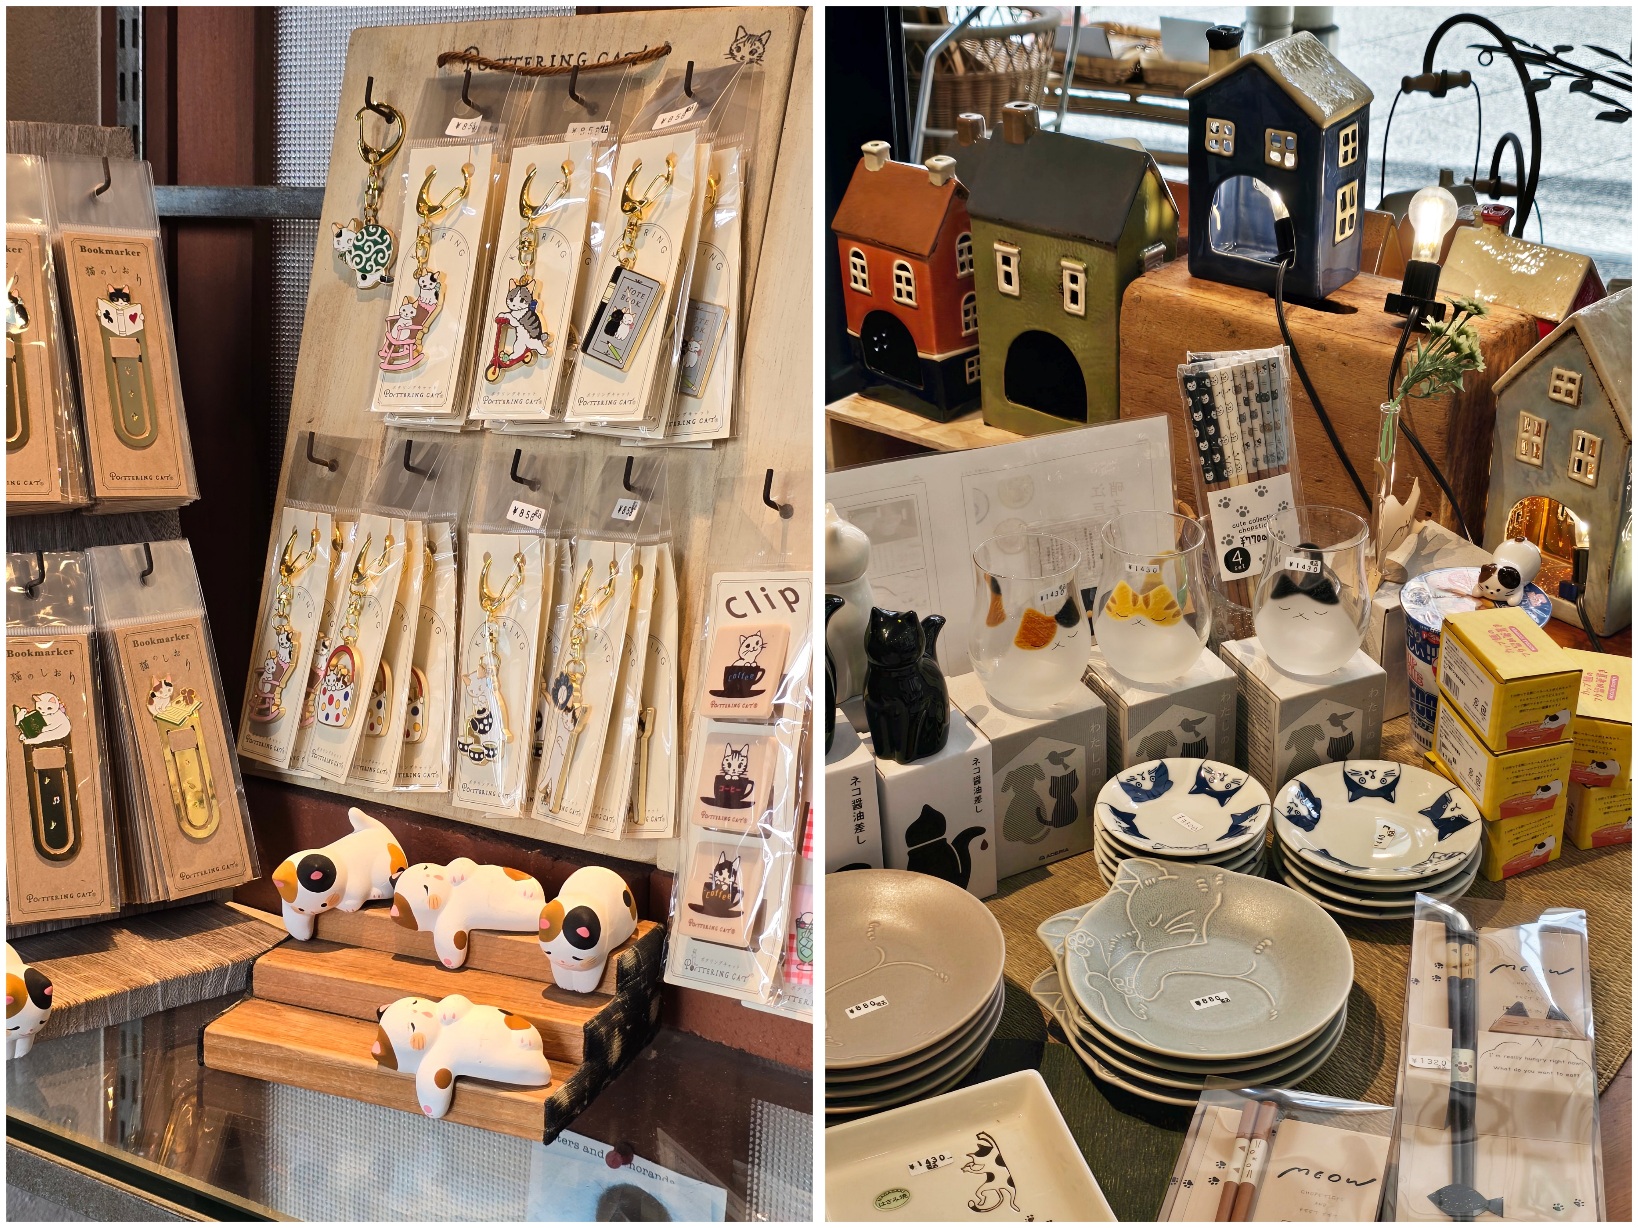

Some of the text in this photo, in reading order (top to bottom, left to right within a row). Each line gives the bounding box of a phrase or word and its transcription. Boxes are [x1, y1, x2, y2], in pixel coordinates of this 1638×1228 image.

[79, 245, 141, 257] Bookmarker
[85, 265, 143, 286] 猫のしおり
[624, 286, 646, 299] NOTE
[620, 294, 641, 308] BOOK
[693, 317, 709, 327] OTE
[1232, 521, 1247, 529] cute
[1238, 522, 1267, 534] chopstic
[1232, 550, 1243, 564] 4
[725, 586, 800, 619] clip
[132, 633, 190, 648] Bookmarker
[6, 648, 74, 658] Bookmarker
[139, 648, 192, 672] 猫のしおり
[10, 668, 76, 685] 猫のしおり
[727, 671, 755, 682] coffee
[719, 785, 741, 793] コーヒー
[850, 776, 866, 845] ネコ醤油差し
[705, 890, 732, 900] coffee
[555, 1135, 580, 1150] ters
[582, 1144, 604, 1159] and
